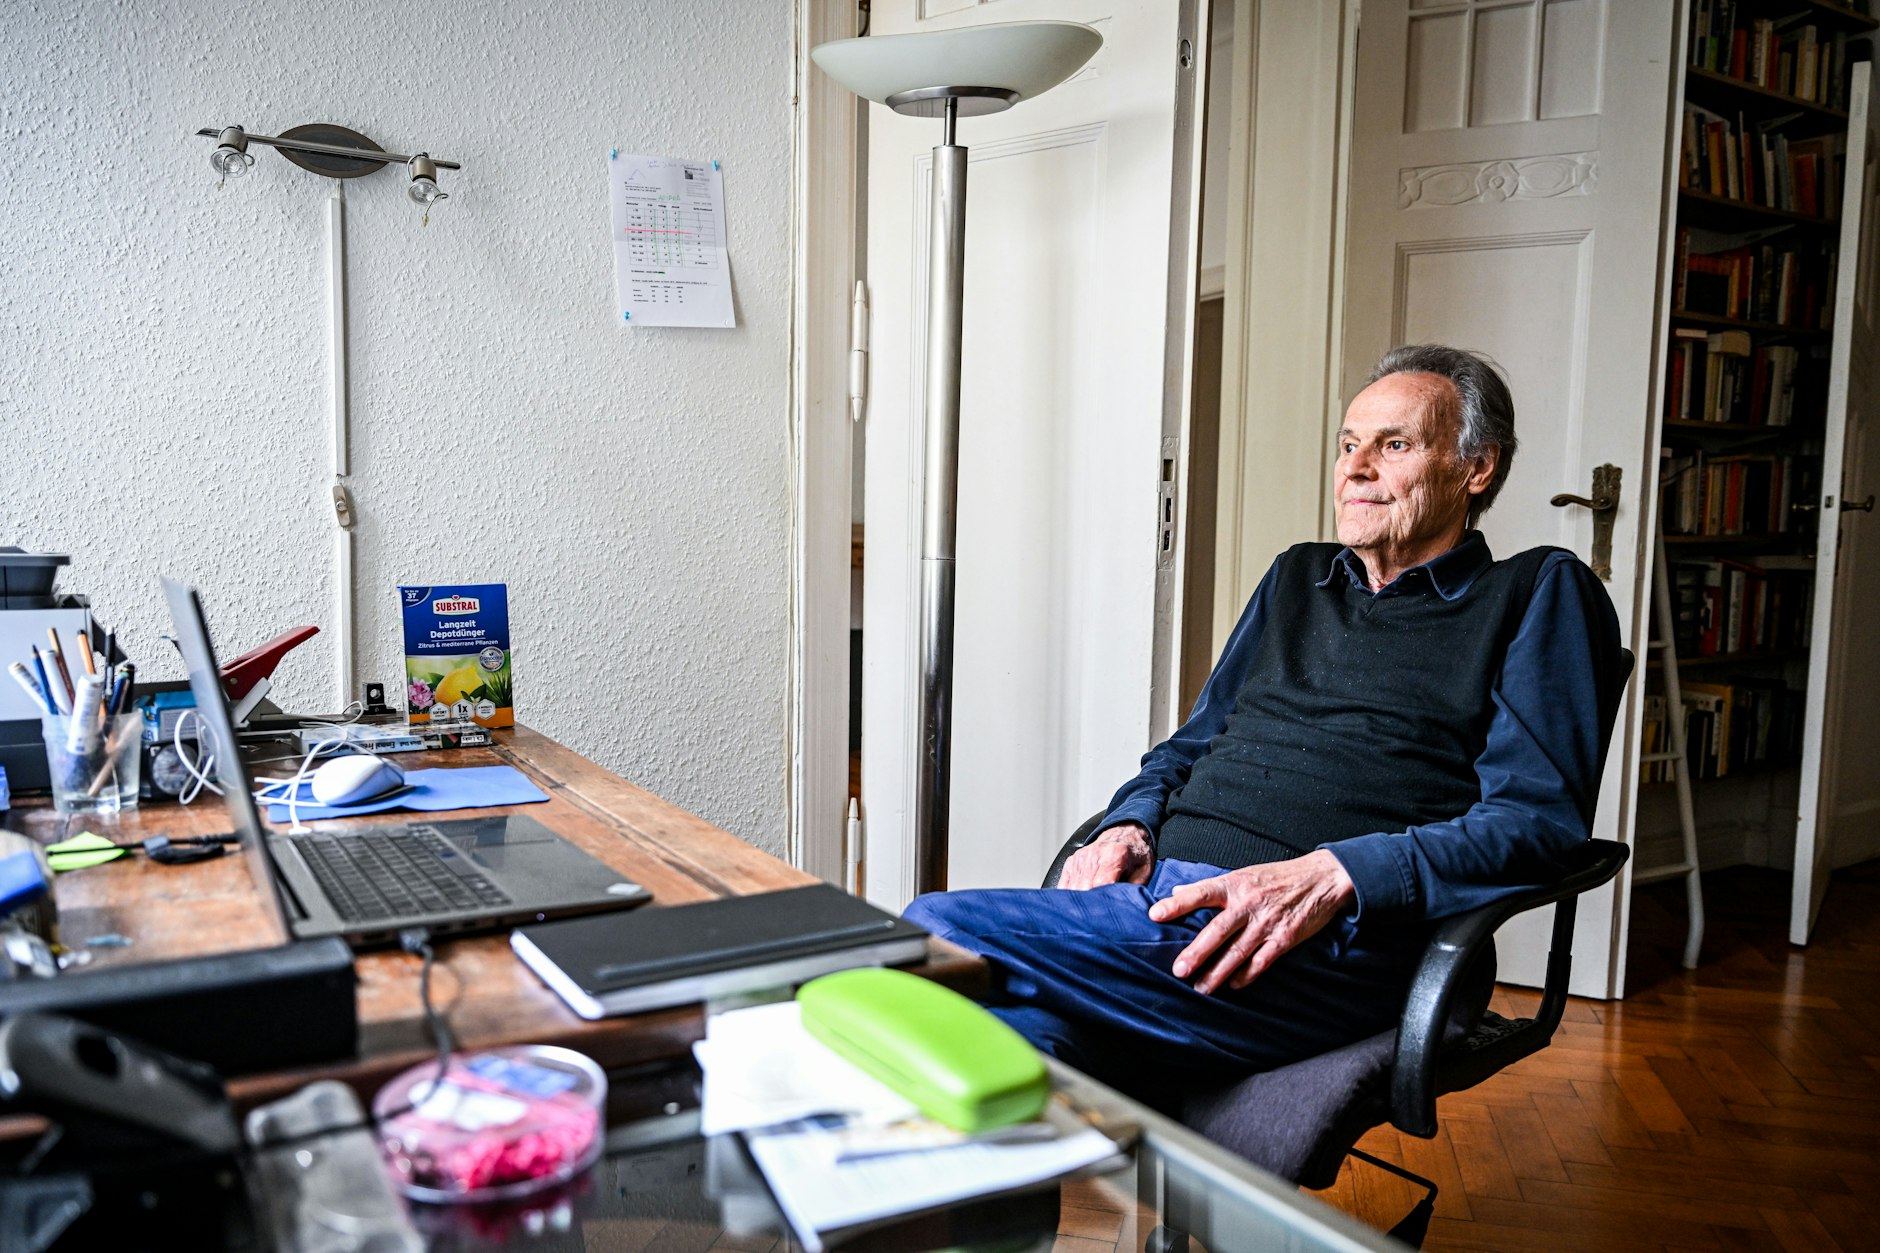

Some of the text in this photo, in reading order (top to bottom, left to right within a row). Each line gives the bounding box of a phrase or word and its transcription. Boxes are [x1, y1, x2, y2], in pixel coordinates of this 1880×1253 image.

[435, 601, 477, 611] SUBSTRAL
[438, 620, 476, 629] Langzeit
[430, 629, 486, 639] Depotdünger
[441, 640, 474, 648] mediterrane
[457, 703, 468, 713] 1x
